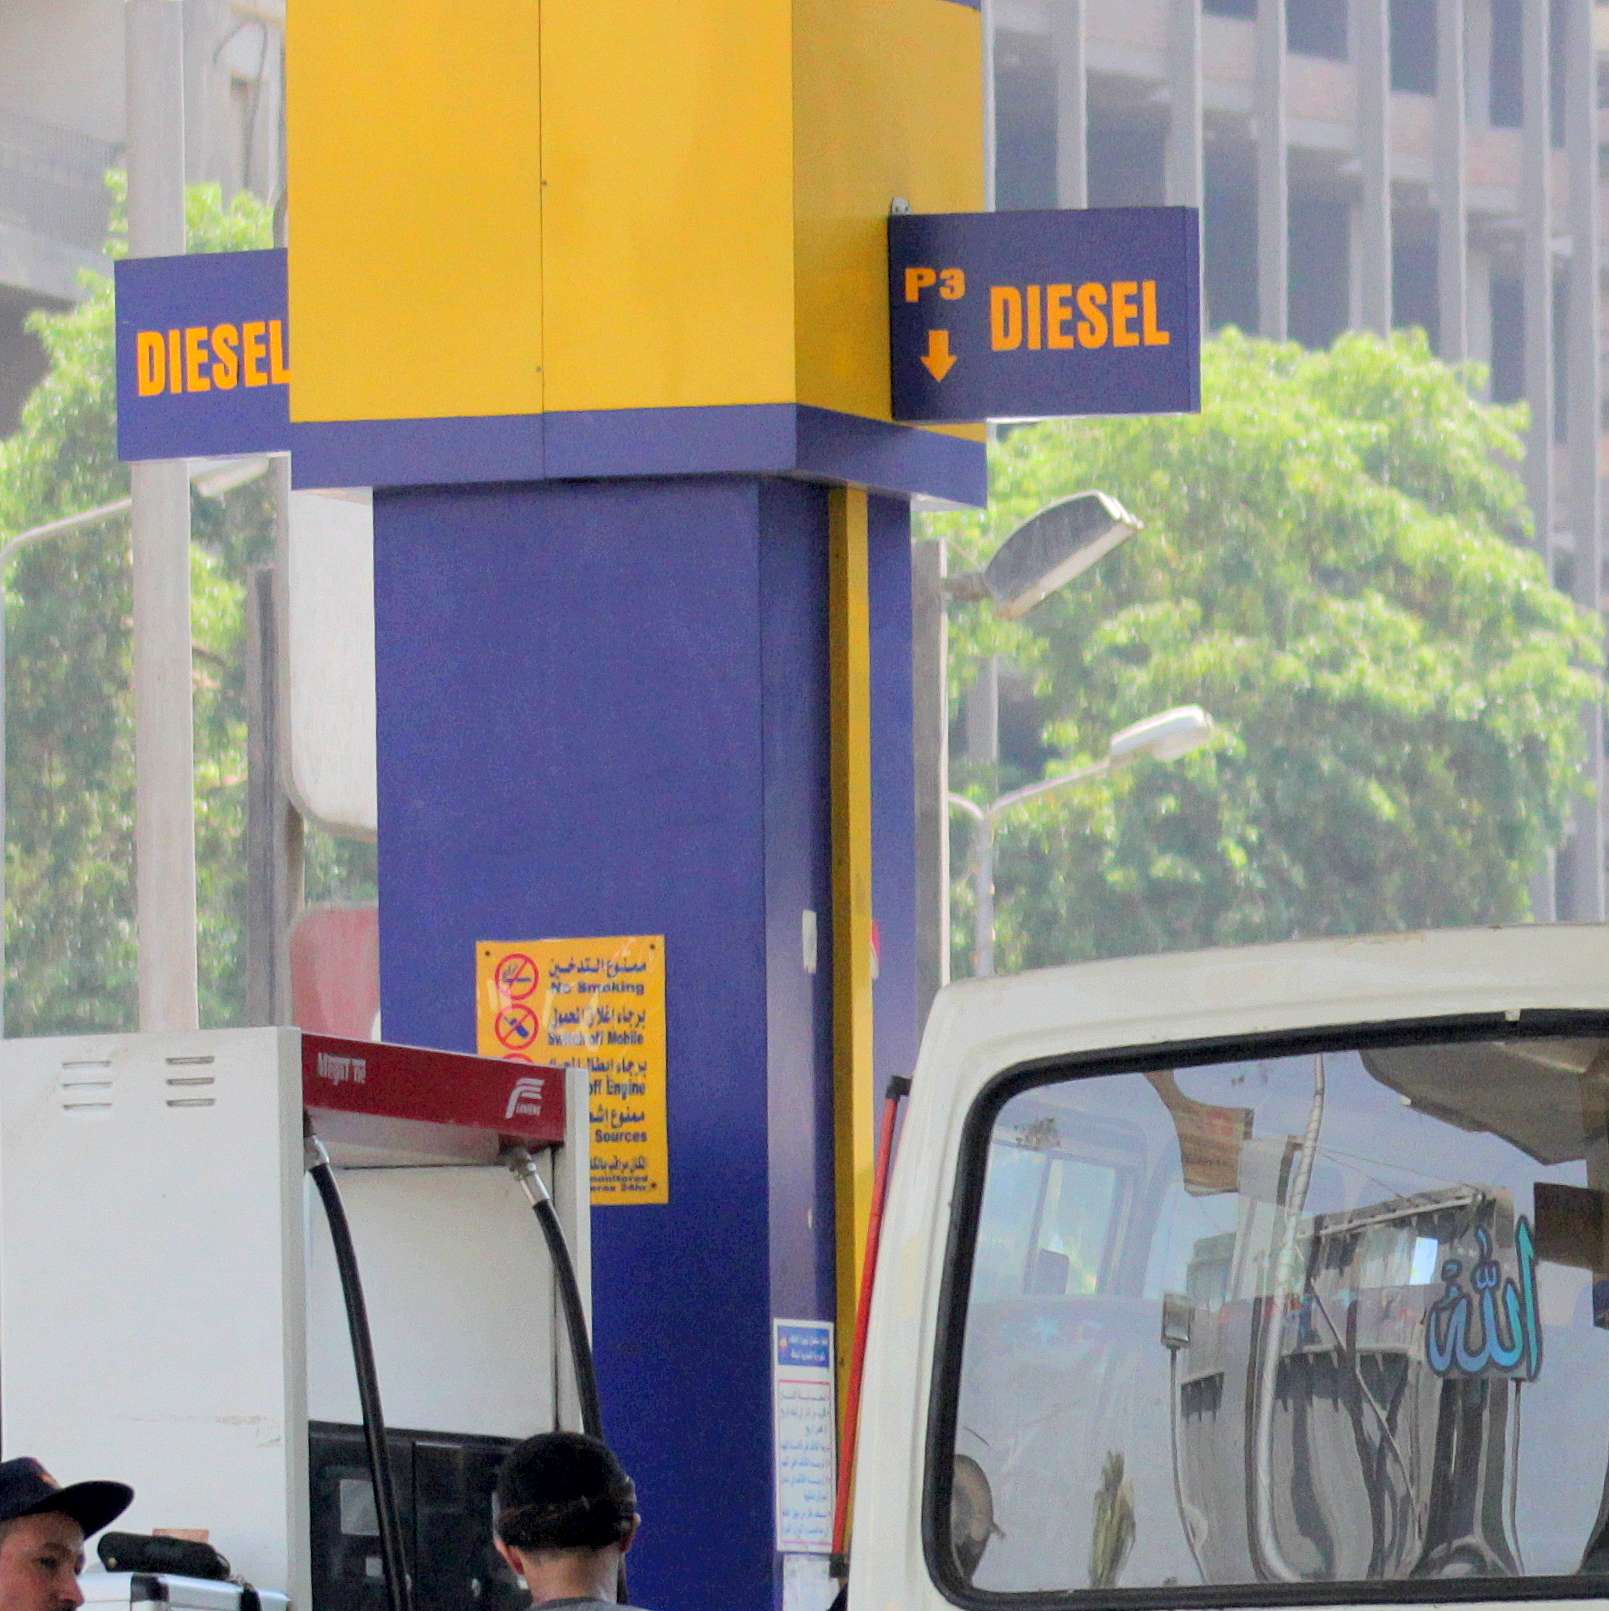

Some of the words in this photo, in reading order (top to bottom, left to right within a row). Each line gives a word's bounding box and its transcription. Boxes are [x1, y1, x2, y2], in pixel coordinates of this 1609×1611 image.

[904, 267, 966, 303] P3
[990, 280, 1170, 351] DIESEL
[136, 320, 292, 396] DIESEL
[606, 956, 646, 978] ممنوع
[578, 981, 645, 995] Smoking
[606, 1075, 646, 1100] Engine
[595, 1129, 648, 1144] Sources
